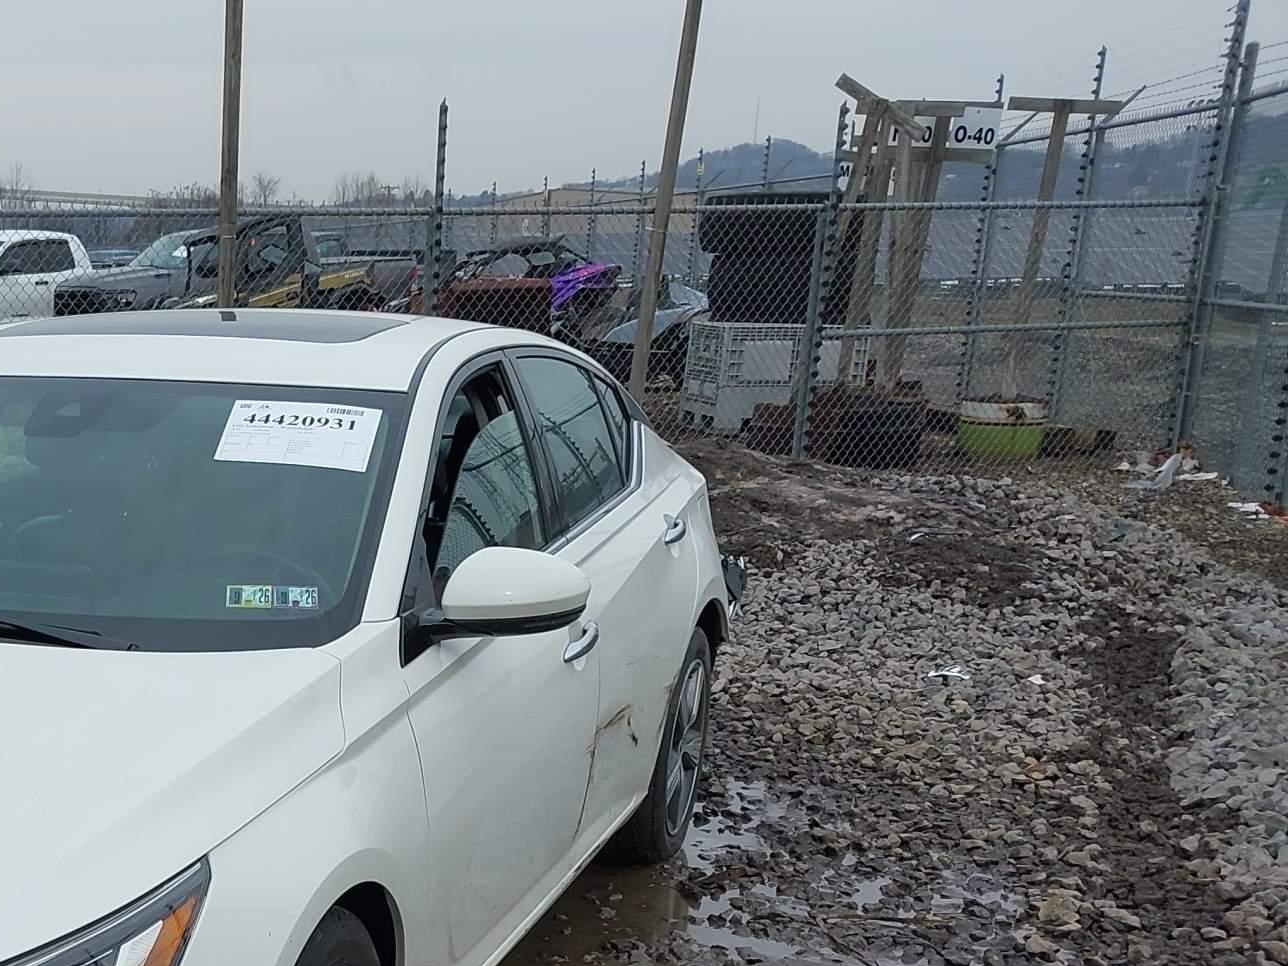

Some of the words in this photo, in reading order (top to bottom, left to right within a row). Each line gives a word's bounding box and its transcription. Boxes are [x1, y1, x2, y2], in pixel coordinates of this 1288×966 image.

[243, 413, 356, 431] 44420931
[258, 588, 269, 604] 26
[305, 589, 316, 605] 26
